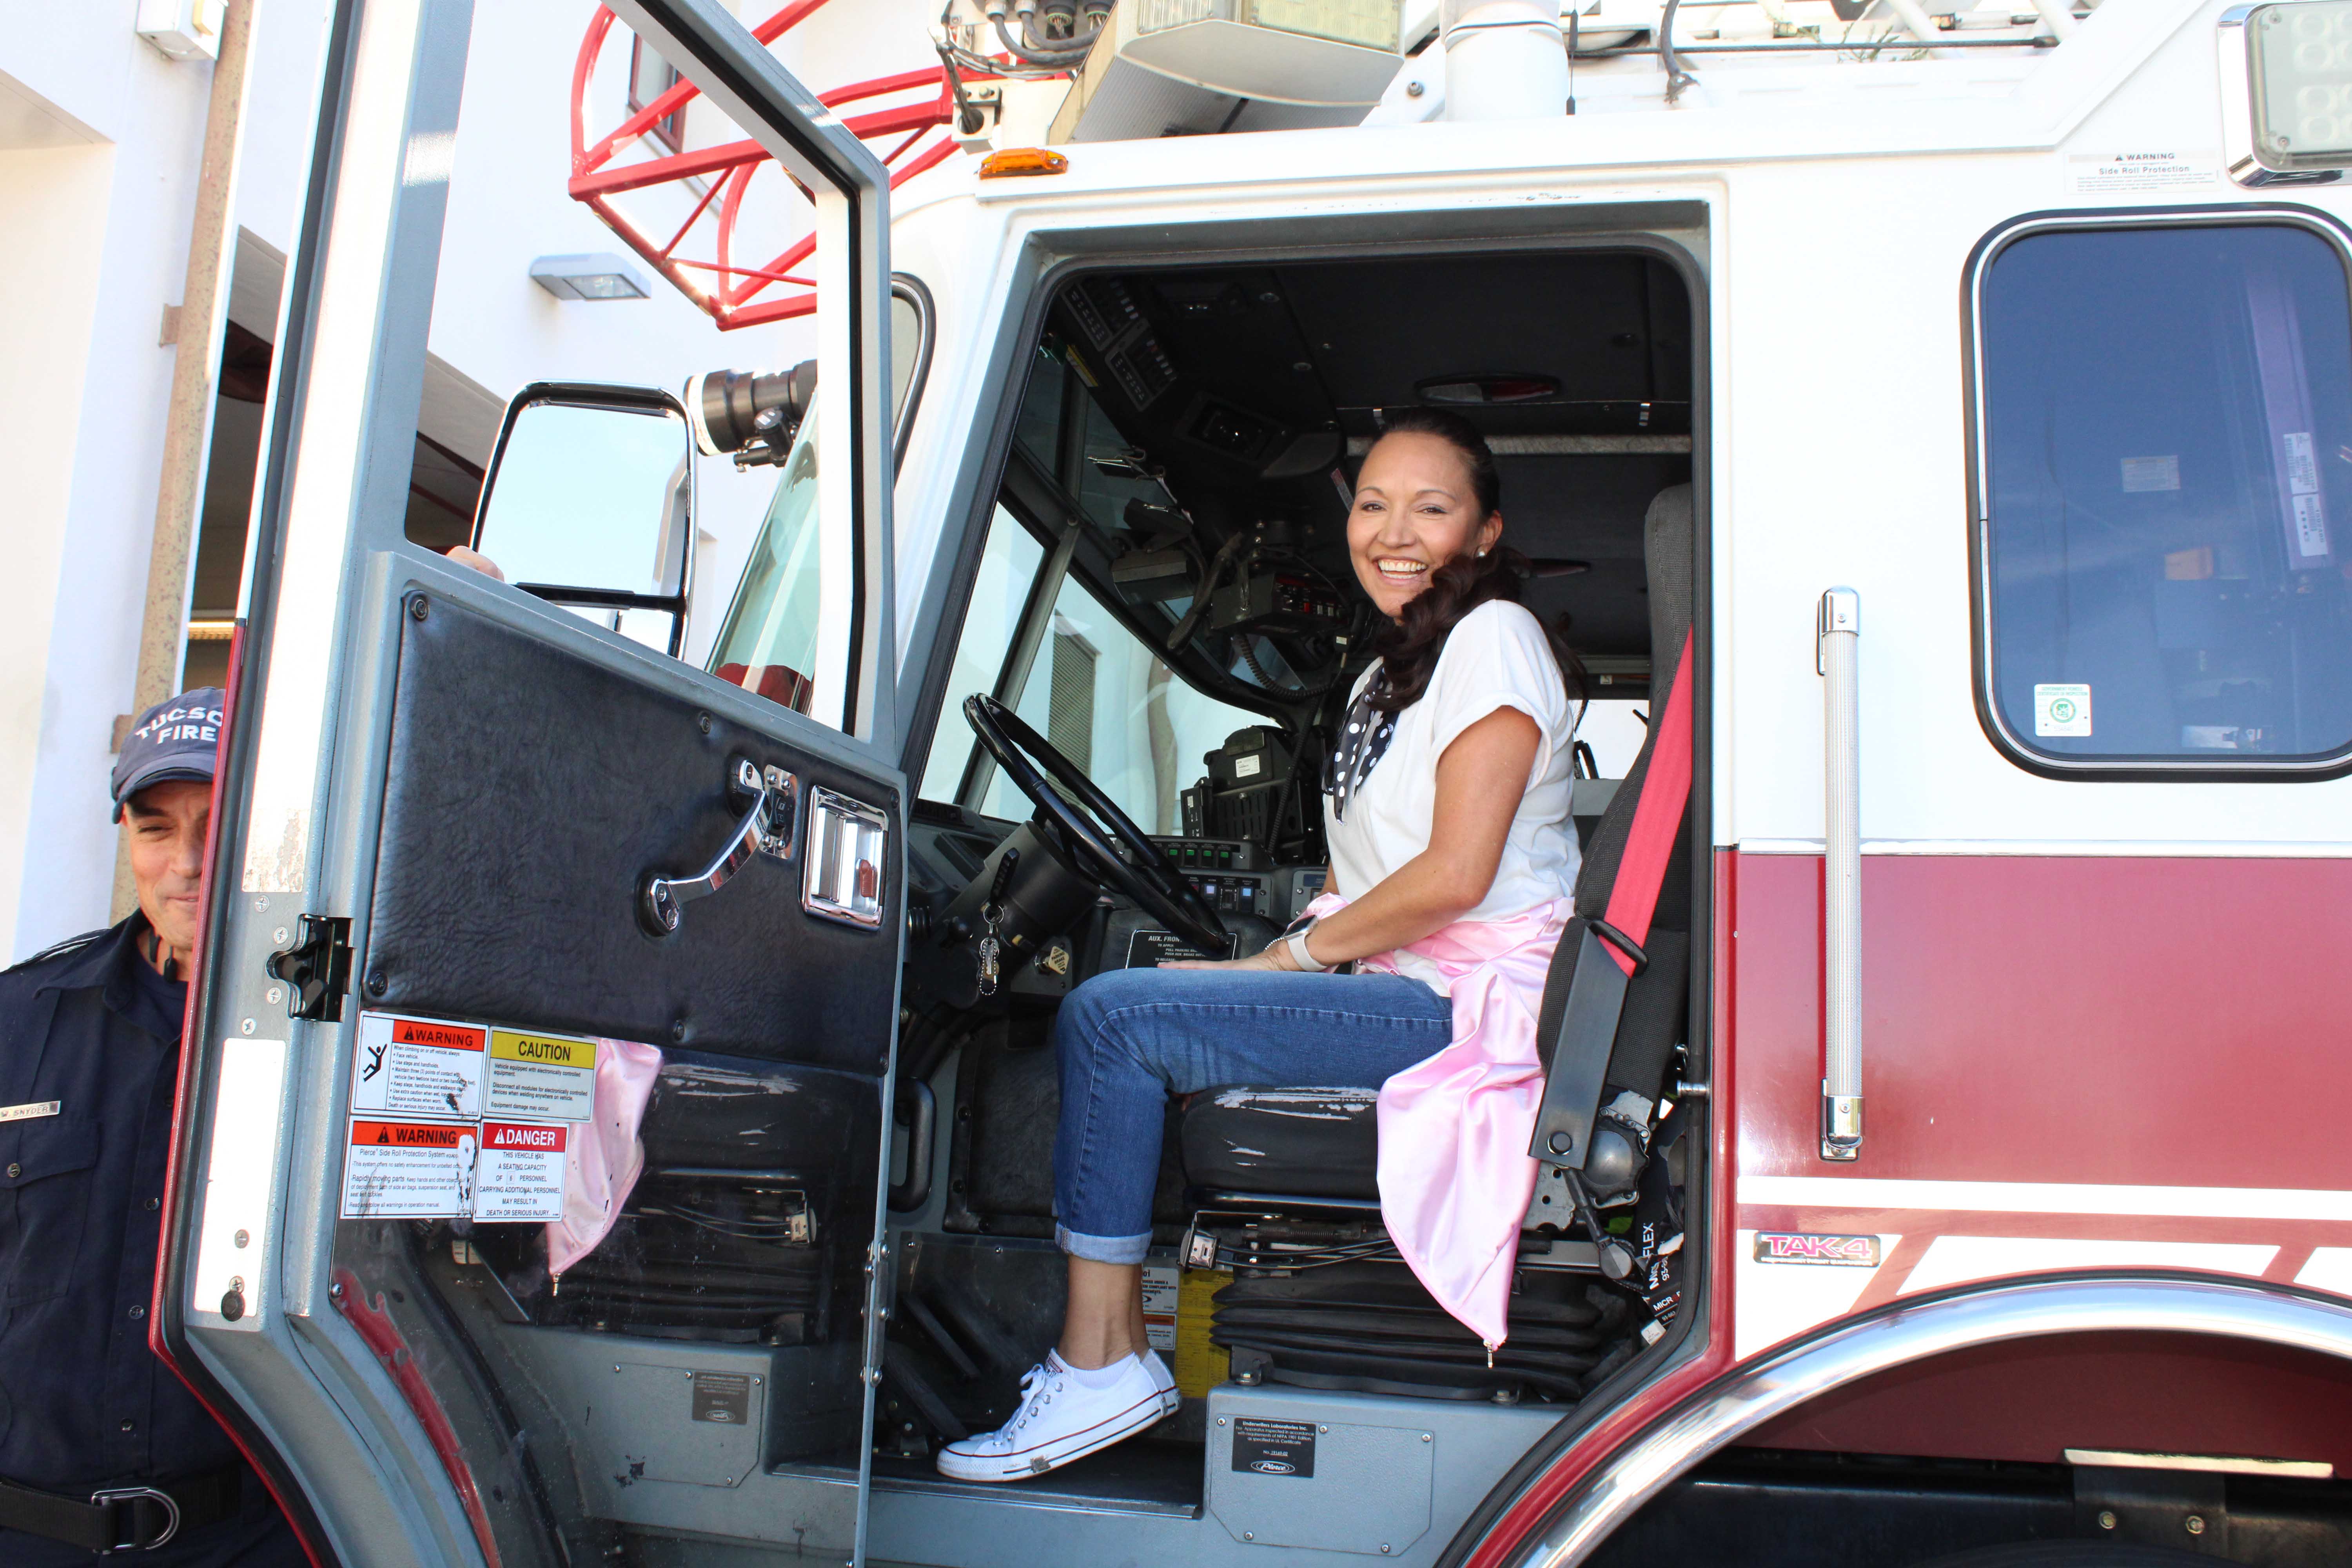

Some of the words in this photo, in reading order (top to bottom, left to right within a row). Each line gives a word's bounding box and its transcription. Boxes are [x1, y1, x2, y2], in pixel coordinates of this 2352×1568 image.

[135, 706, 223, 739] TUCSO
[157, 725, 216, 744] FIRE
[416, 1029, 473, 1046] WARNING
[519, 1041, 571, 1061] CAUTION
[537, 1068, 561, 1076] electronically
[14, 1106, 49, 1116] SNYDER
[396, 1128, 457, 1143] WARNING
[506, 1129, 555, 1146] DANGER
[428, 1150, 446, 1158] System
[1761, 1234, 1873, 1259] TAK-4
[1260, 1463, 1286, 1471] Pierce
